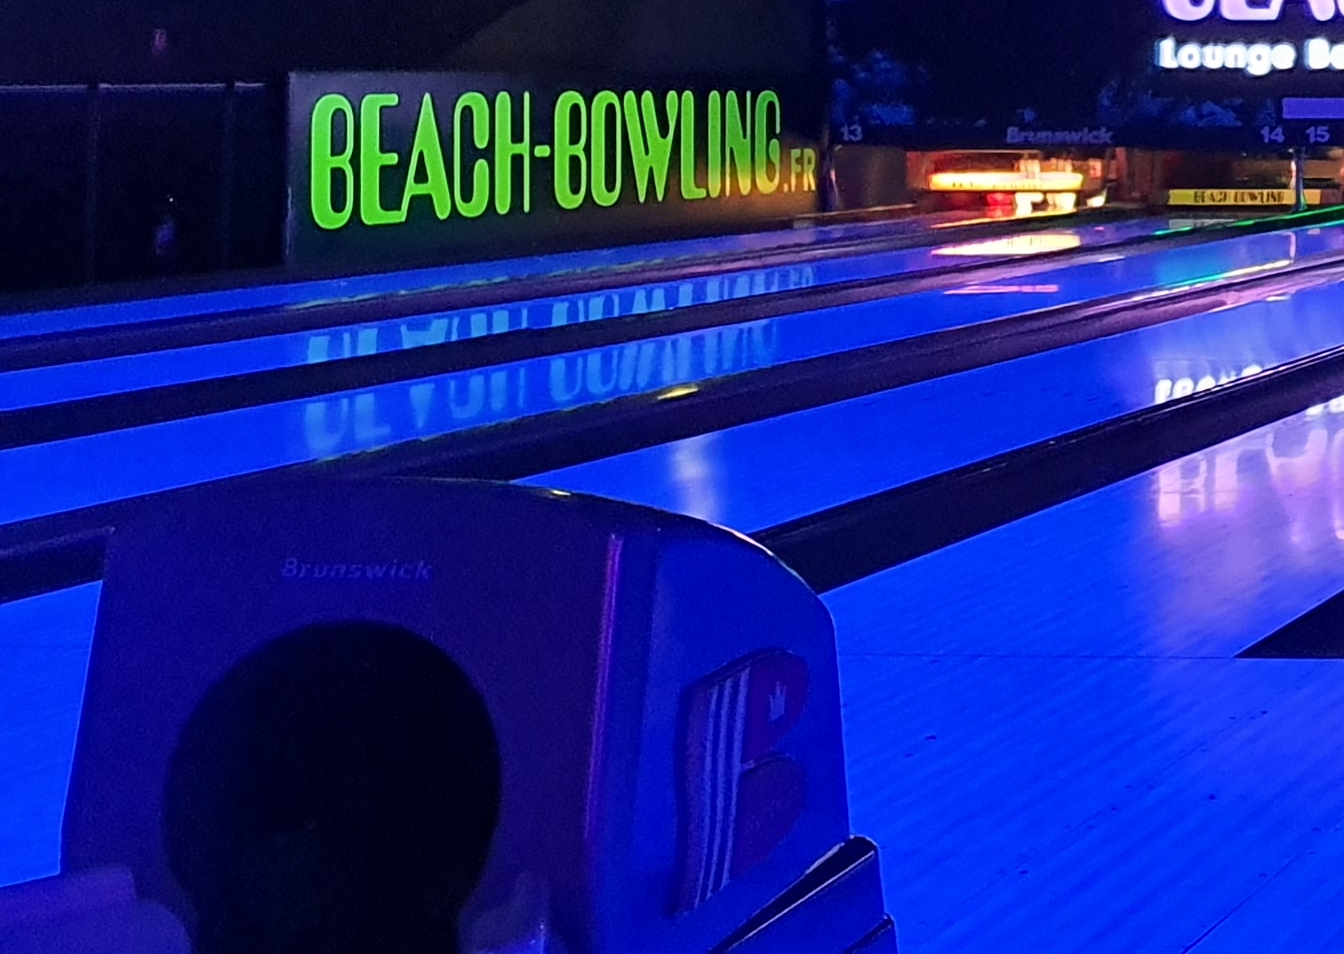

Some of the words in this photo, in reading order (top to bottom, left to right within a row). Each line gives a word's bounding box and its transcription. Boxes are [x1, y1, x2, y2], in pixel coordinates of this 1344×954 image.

[1157, 37, 1295, 75] Lounge
[839, 124, 863, 142] 13
[1006, 125, 1113, 144] Brunswick
[1260, 125, 1285, 144] 14
[1305, 125, 1330, 143] 15
[281, 557, 433, 581] Brunswick
